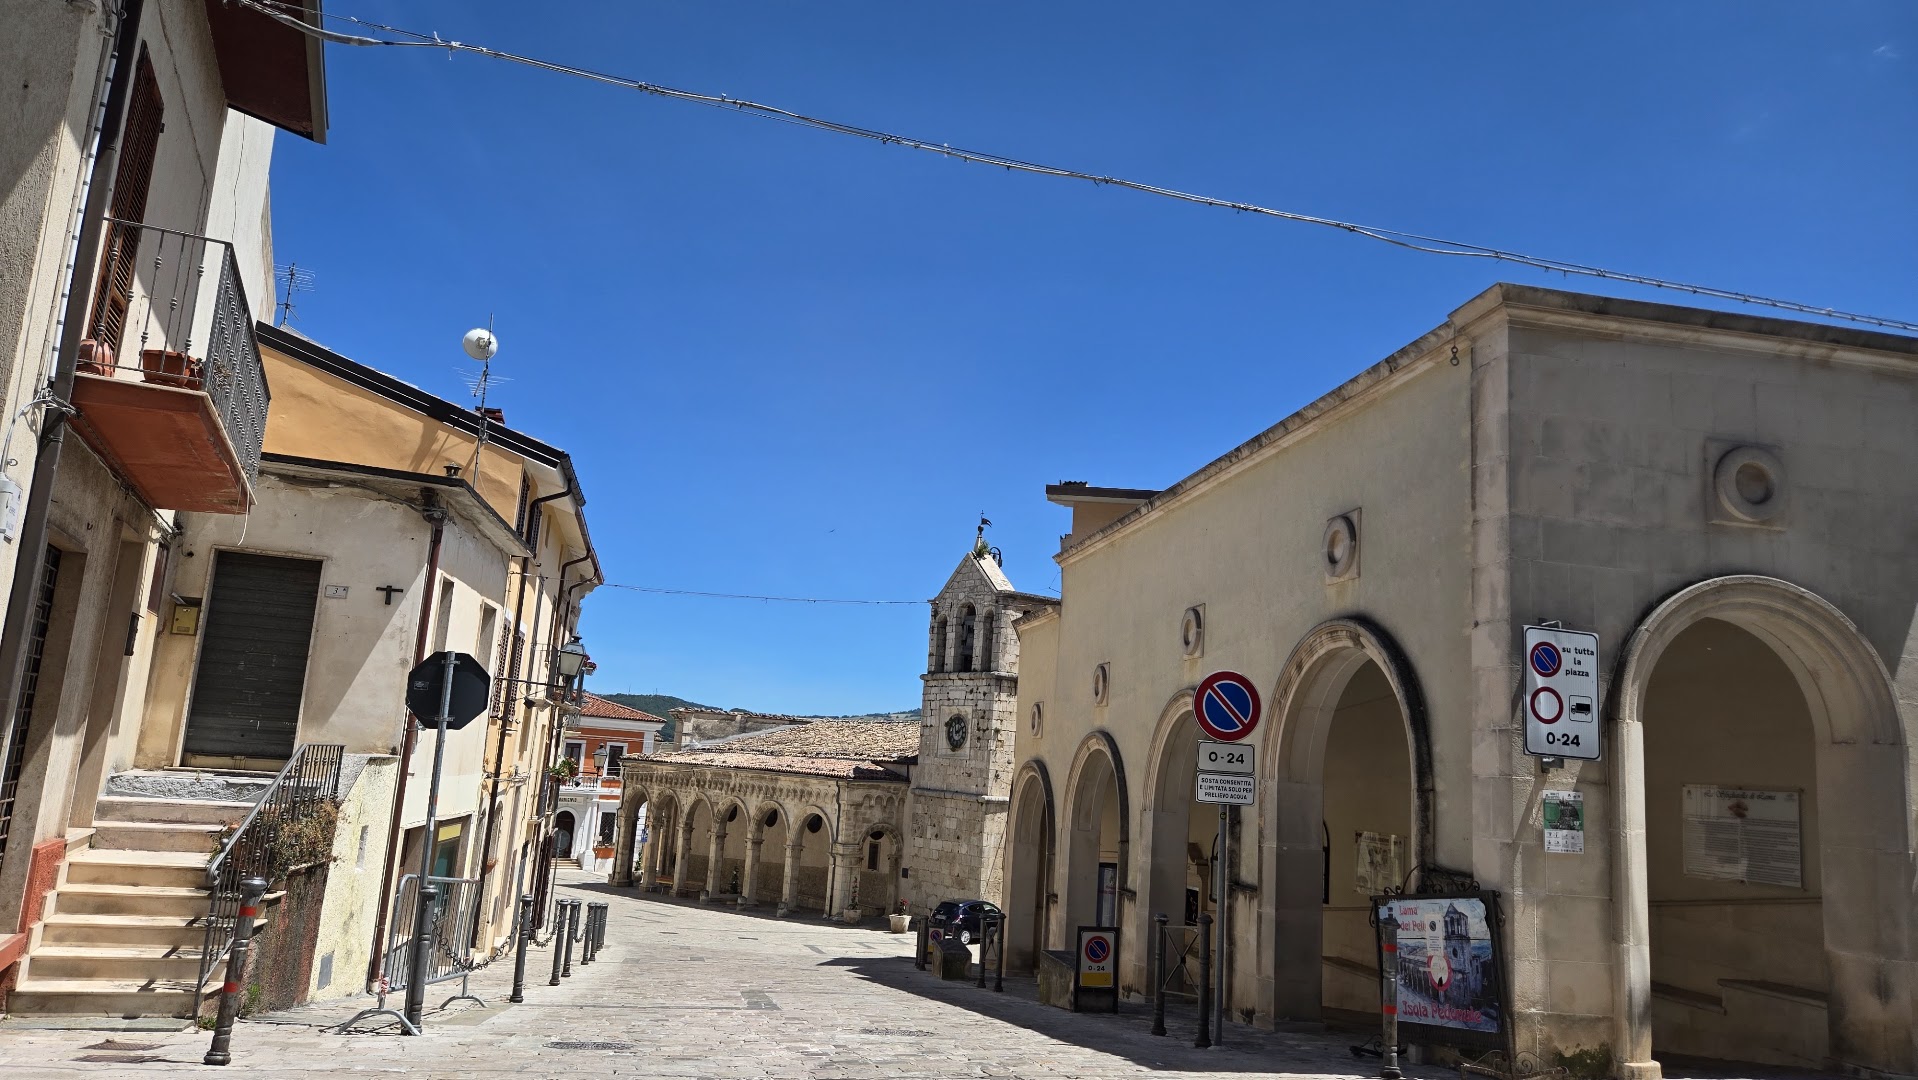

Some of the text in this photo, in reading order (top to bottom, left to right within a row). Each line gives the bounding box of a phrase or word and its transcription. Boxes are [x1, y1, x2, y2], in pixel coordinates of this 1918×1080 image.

[332, 587, 339, 595] 3
[1561, 646, 1595, 656] su tutta
[1573, 657, 1582, 666] la
[1565, 668, 1589, 677] piazza
[1546, 731, 1581, 748] 0-24
[1402, 1000, 1429, 1018] Isola
